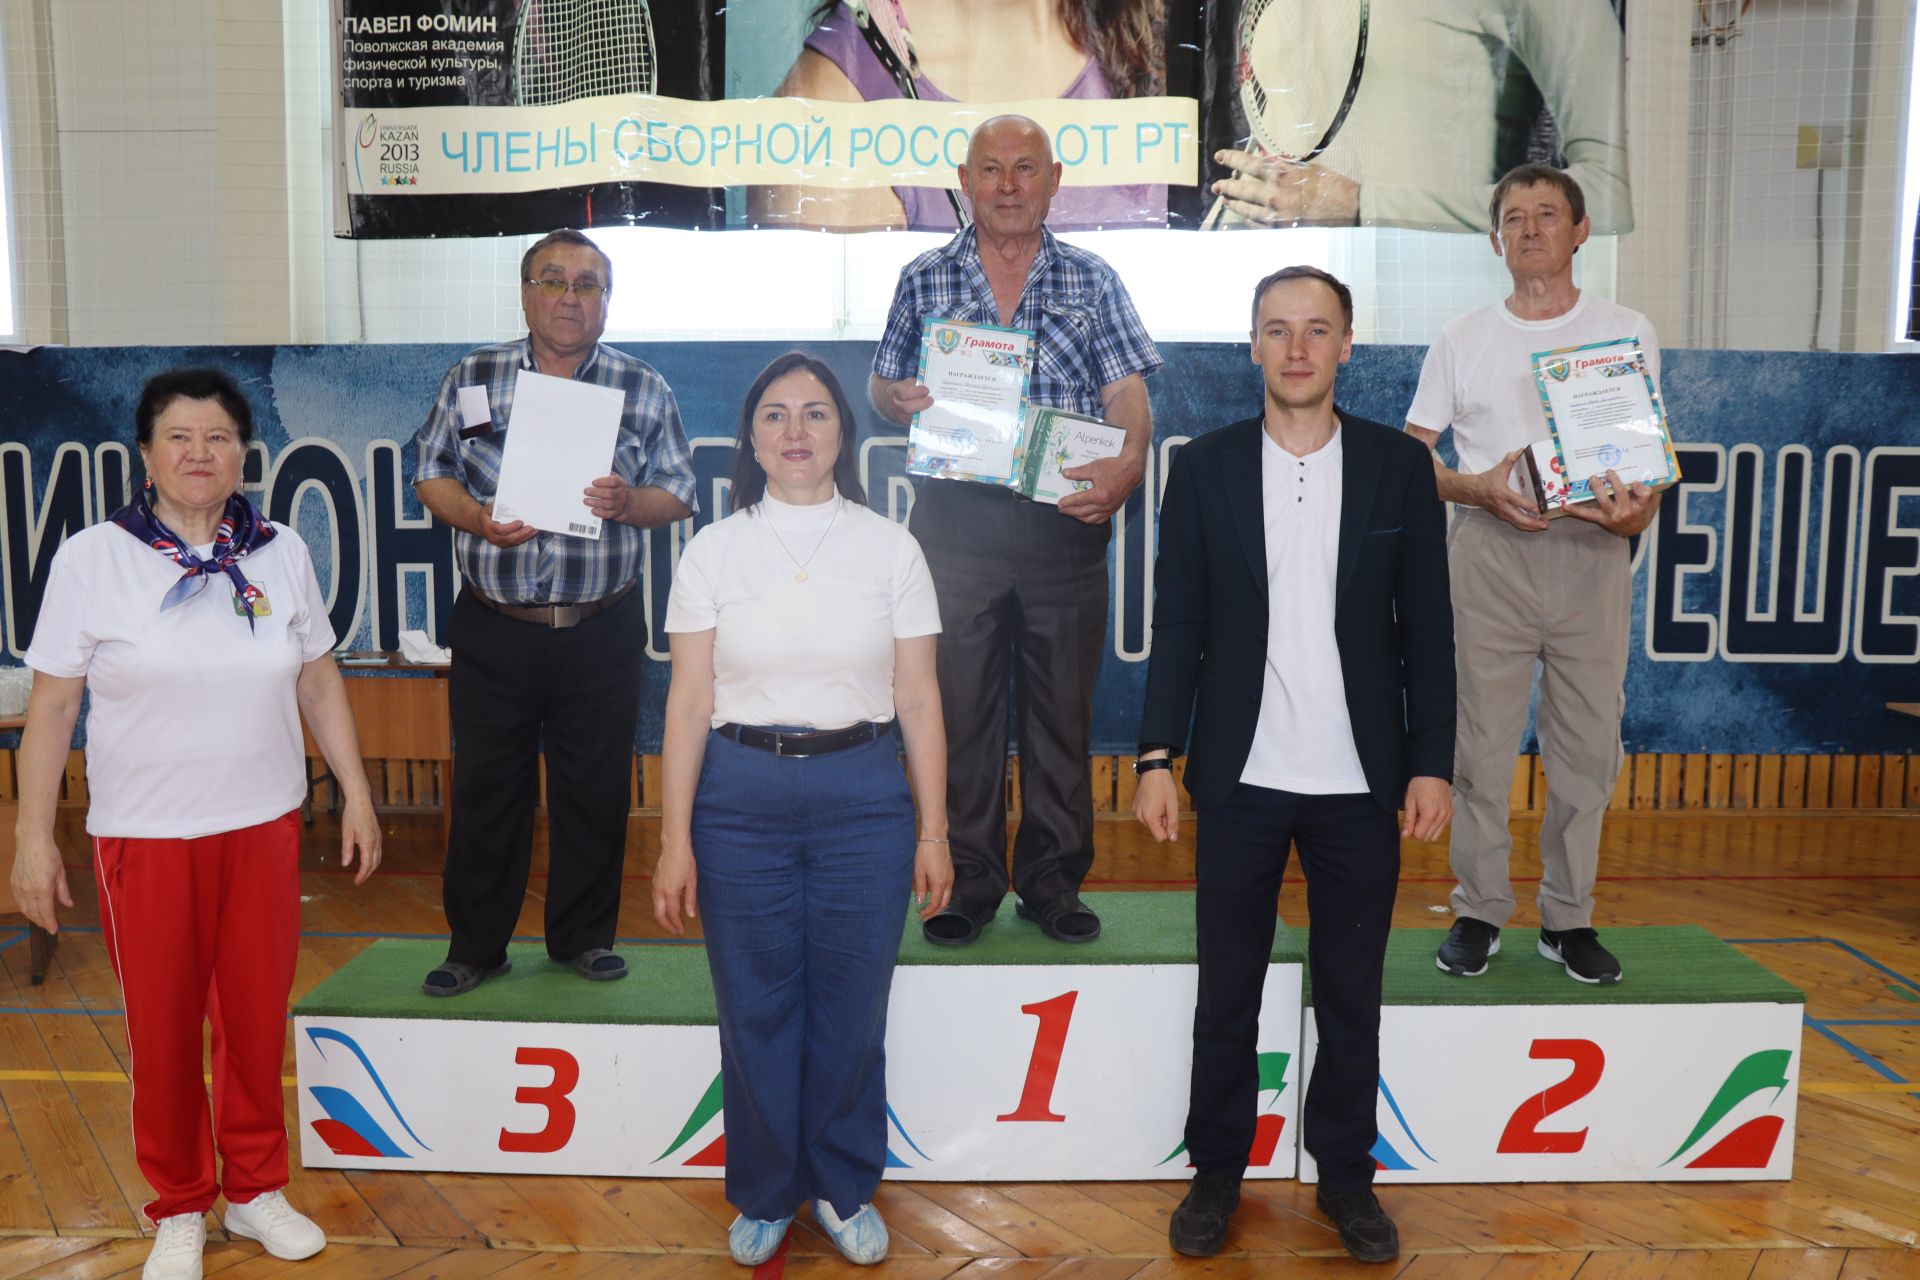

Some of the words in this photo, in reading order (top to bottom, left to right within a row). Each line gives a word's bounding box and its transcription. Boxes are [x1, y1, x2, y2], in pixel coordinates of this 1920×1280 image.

[343, 15, 411, 34] ПАВЕЛ
[416, 14, 497, 33] ФОМИН
[343, 39, 428, 53] Поволжская
[431, 38, 505, 53] академия
[343, 56, 427, 73] физической
[431, 56, 502, 73] культуры,
[343, 77, 393, 92] спорта
[396, 78, 405, 88] и
[408, 75, 466, 90] туризма
[380, 131, 419, 141] KAZAN
[441, 121, 597, 174] ЧЛЕНЫ
[613, 115, 832, 168] СБОРНОЙ
[849, 125, 968, 168] РОСС
[1055, 123, 1119, 167] ОТ
[1136, 121, 1189, 165] РТ
[380, 143, 420, 161] 2013
[380, 163, 420, 174] RUSSIA
[964, 336, 1015, 351] Грамота
[1575, 354, 1625, 369] Грамота
[994, 989, 1080, 1123] 1
[497, 1045, 581, 1154] 3
[1495, 1037, 1606, 1154] 2
